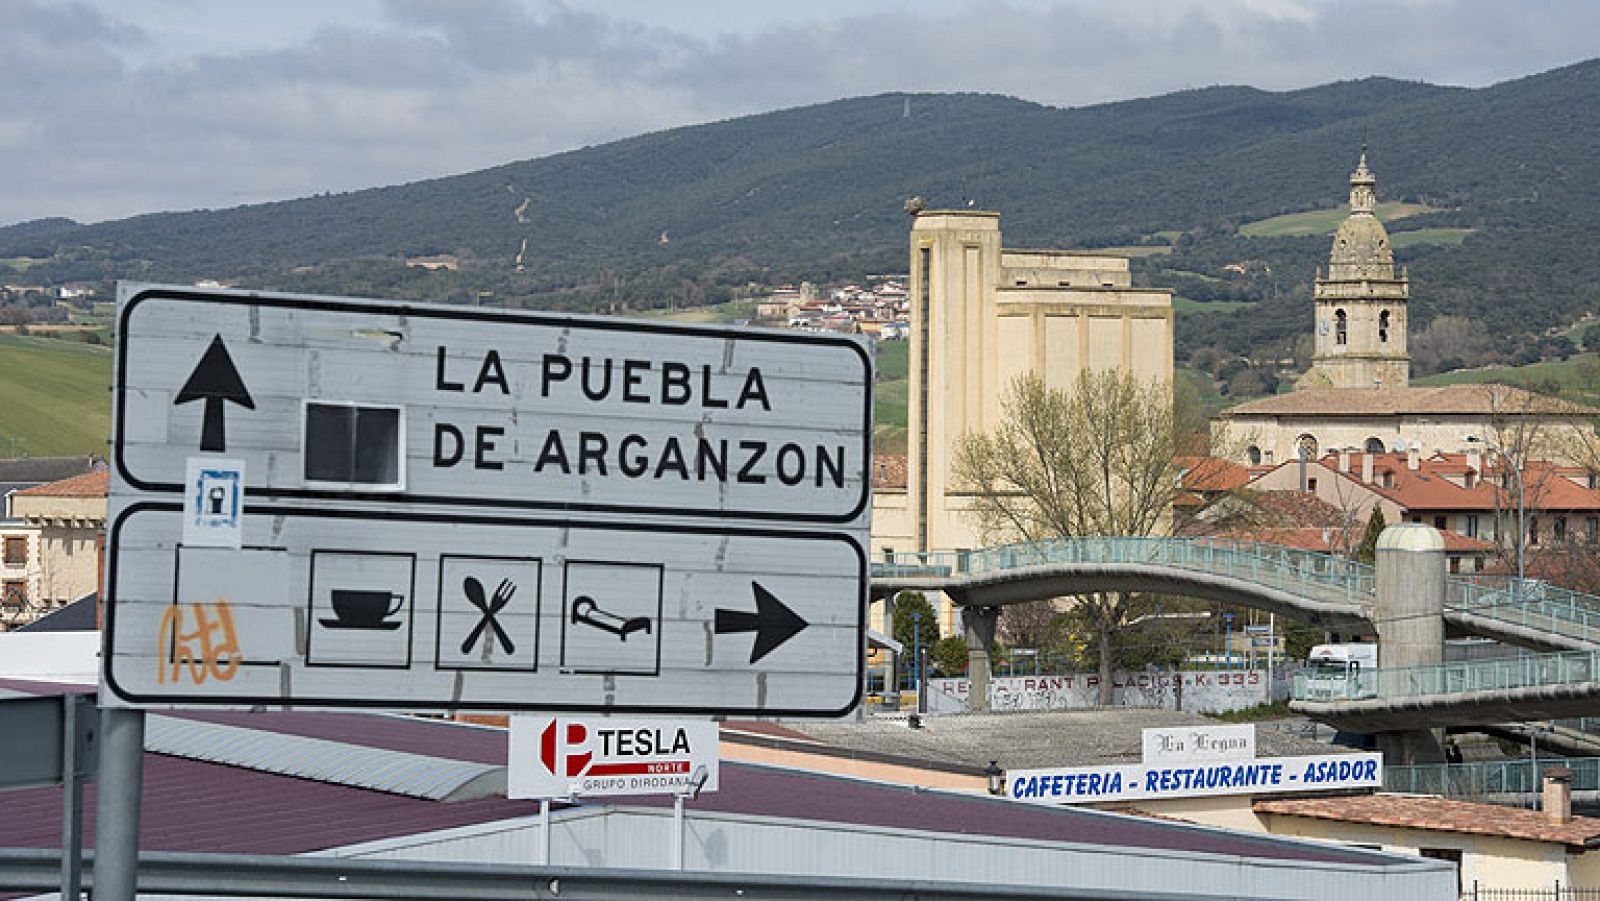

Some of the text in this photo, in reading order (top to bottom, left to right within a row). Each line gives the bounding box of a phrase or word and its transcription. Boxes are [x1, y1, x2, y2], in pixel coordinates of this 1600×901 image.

[436, 346, 771, 411] LA PUEBLA
[433, 423, 845, 488] DE ARGANZON
[598, 728, 691, 756] TESLA
[583, 778, 626, 791] GRUPO
[647, 762, 683, 773] NORTE
[1013, 771, 1122, 799] CAFETERIA
[1128, 781, 1138, 789] -
[1145, 764, 1282, 793] RESTAURANTE
[1303, 758, 1377, 783] ASADOR
